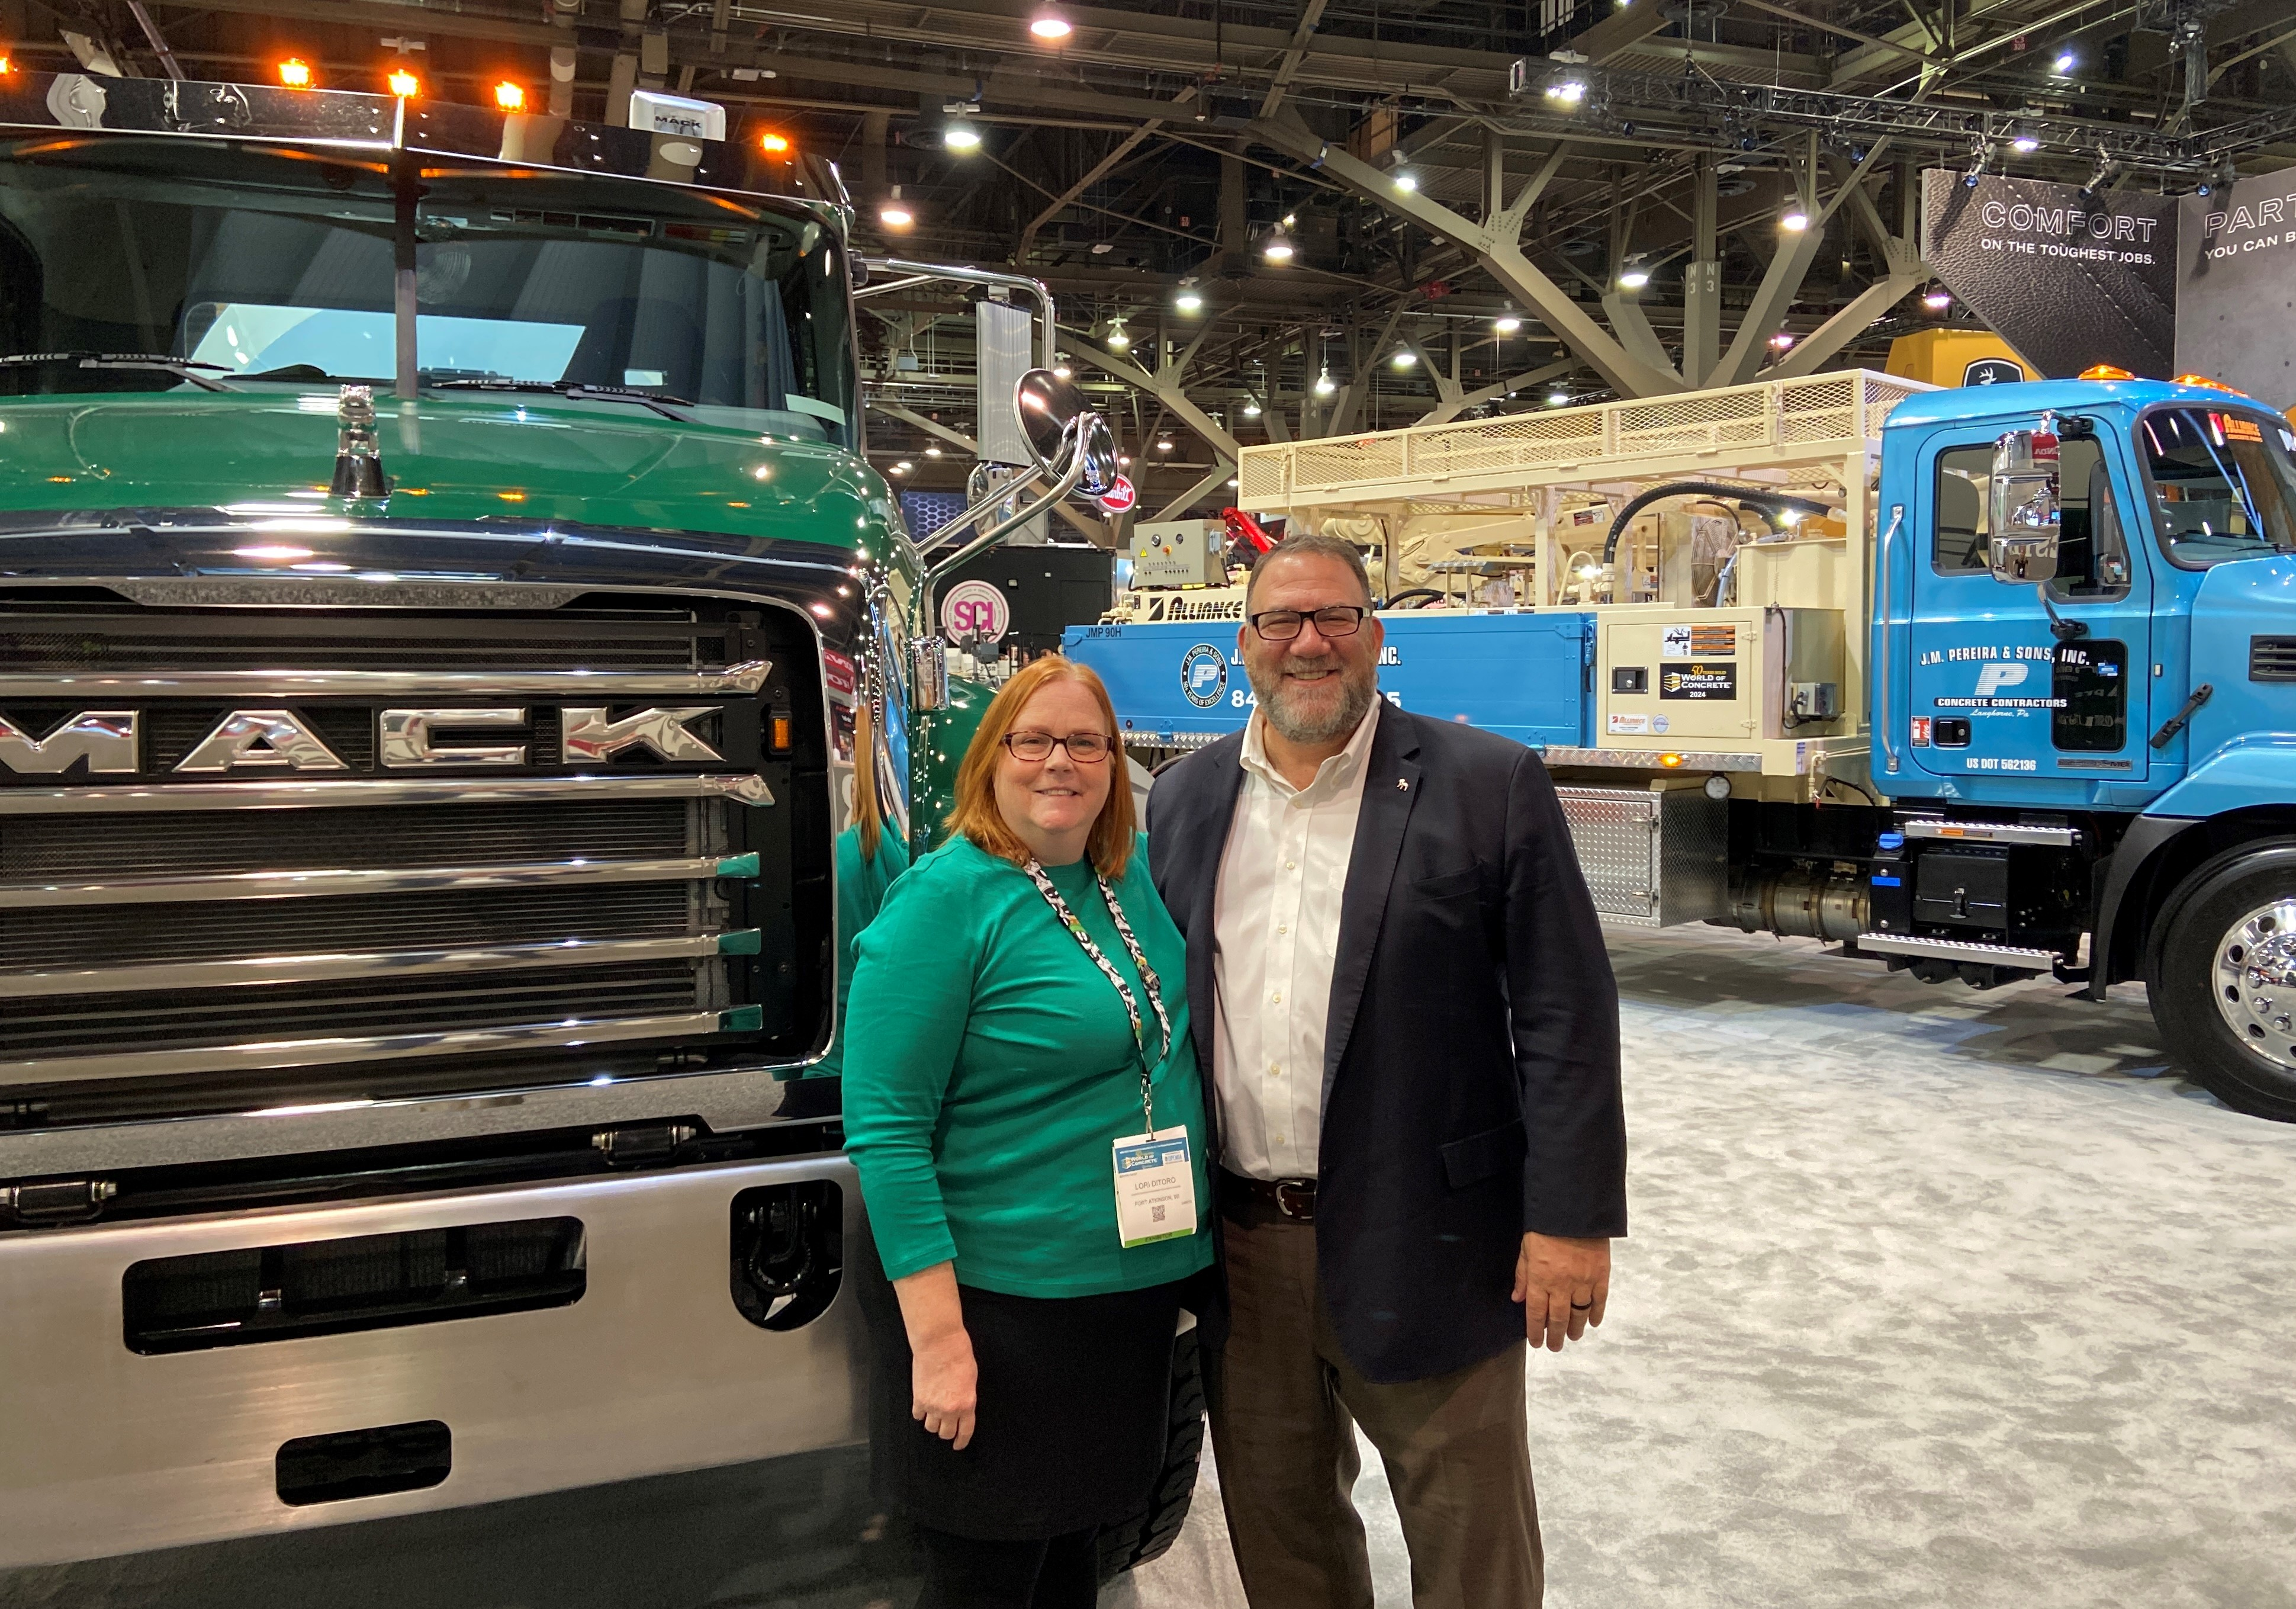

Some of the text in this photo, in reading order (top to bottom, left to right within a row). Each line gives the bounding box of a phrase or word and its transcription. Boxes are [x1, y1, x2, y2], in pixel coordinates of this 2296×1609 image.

[654, 115, 702, 129] MACK
[1982, 201, 2157, 243] COMFORT
[1981, 239, 2156, 265] ON THE TOUGHEST JOBS.
[2205, 244, 2237, 259] YOU
[2243, 235, 2278, 252] CAN
[1167, 596, 1243, 621] ALLIANCE
[1086, 627, 1121, 638] JMP 90H
[1192, 646, 1209, 657] PEREIRA
[1213, 651, 1224, 666] SONS
[1921, 646, 2090, 666] J.M. PEREIRA & SONS, INC.
[1187, 689, 1199, 705] YEARS
[1204, 682, 1226, 706] EXCELLENCE
[1938, 698, 2067, 708] CONCRETE CONTRACTORS
[2016, 709, 2030, 718] Pa
[1966, 758, 1979, 769] US
[1980, 758, 1999, 769] DOT
[1135, 1177, 1176, 1190] LORI DITORO
